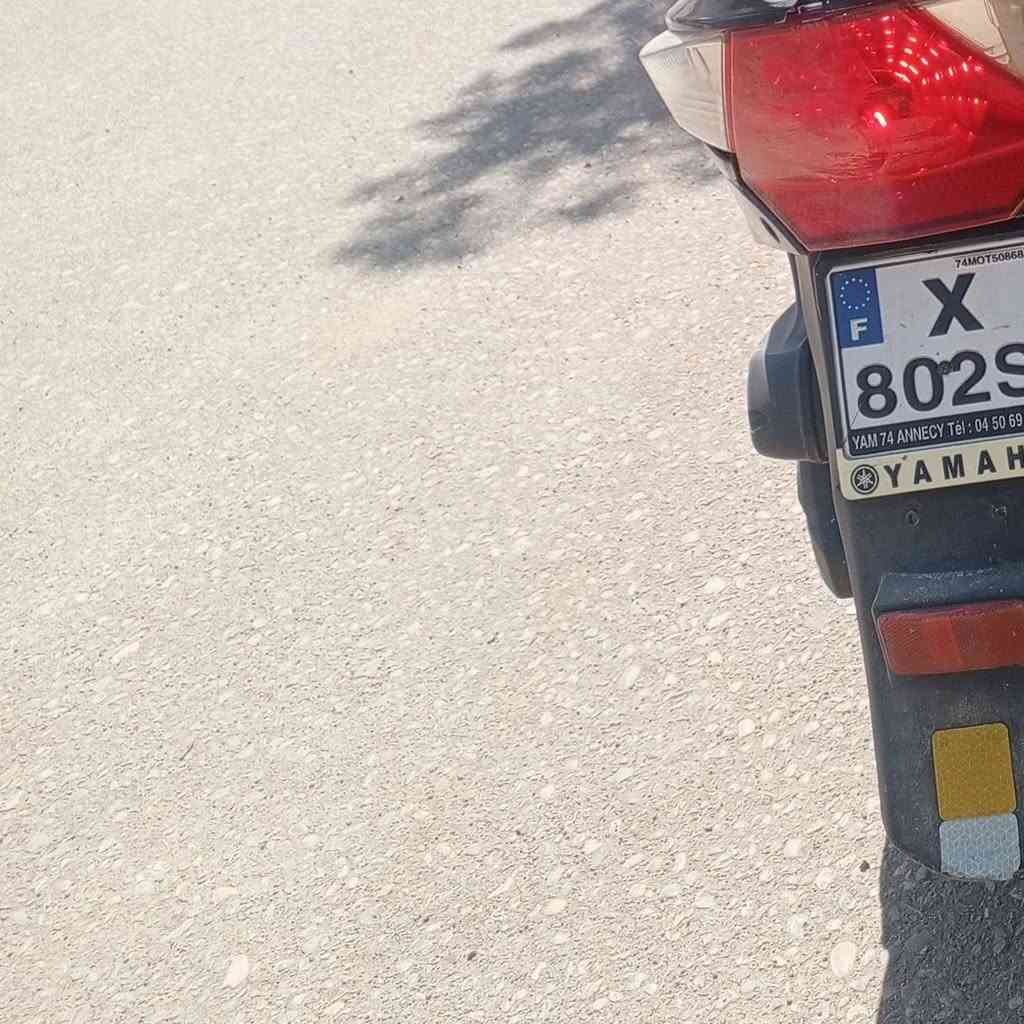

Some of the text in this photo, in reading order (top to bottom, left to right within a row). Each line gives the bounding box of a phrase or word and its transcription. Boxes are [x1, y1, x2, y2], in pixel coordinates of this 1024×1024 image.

[922, 272, 984, 337] X
[850, 318, 868, 341] F
[852, 433, 878, 449] YAM
[880, 431, 894, 446] 74
[897, 423, 944, 444] ANNECY
[947, 419, 965, 436] Tél
[975, 417, 988, 432] 04
[992, 415, 1006, 430] 50
[1009, 413, 1023, 428] 69
